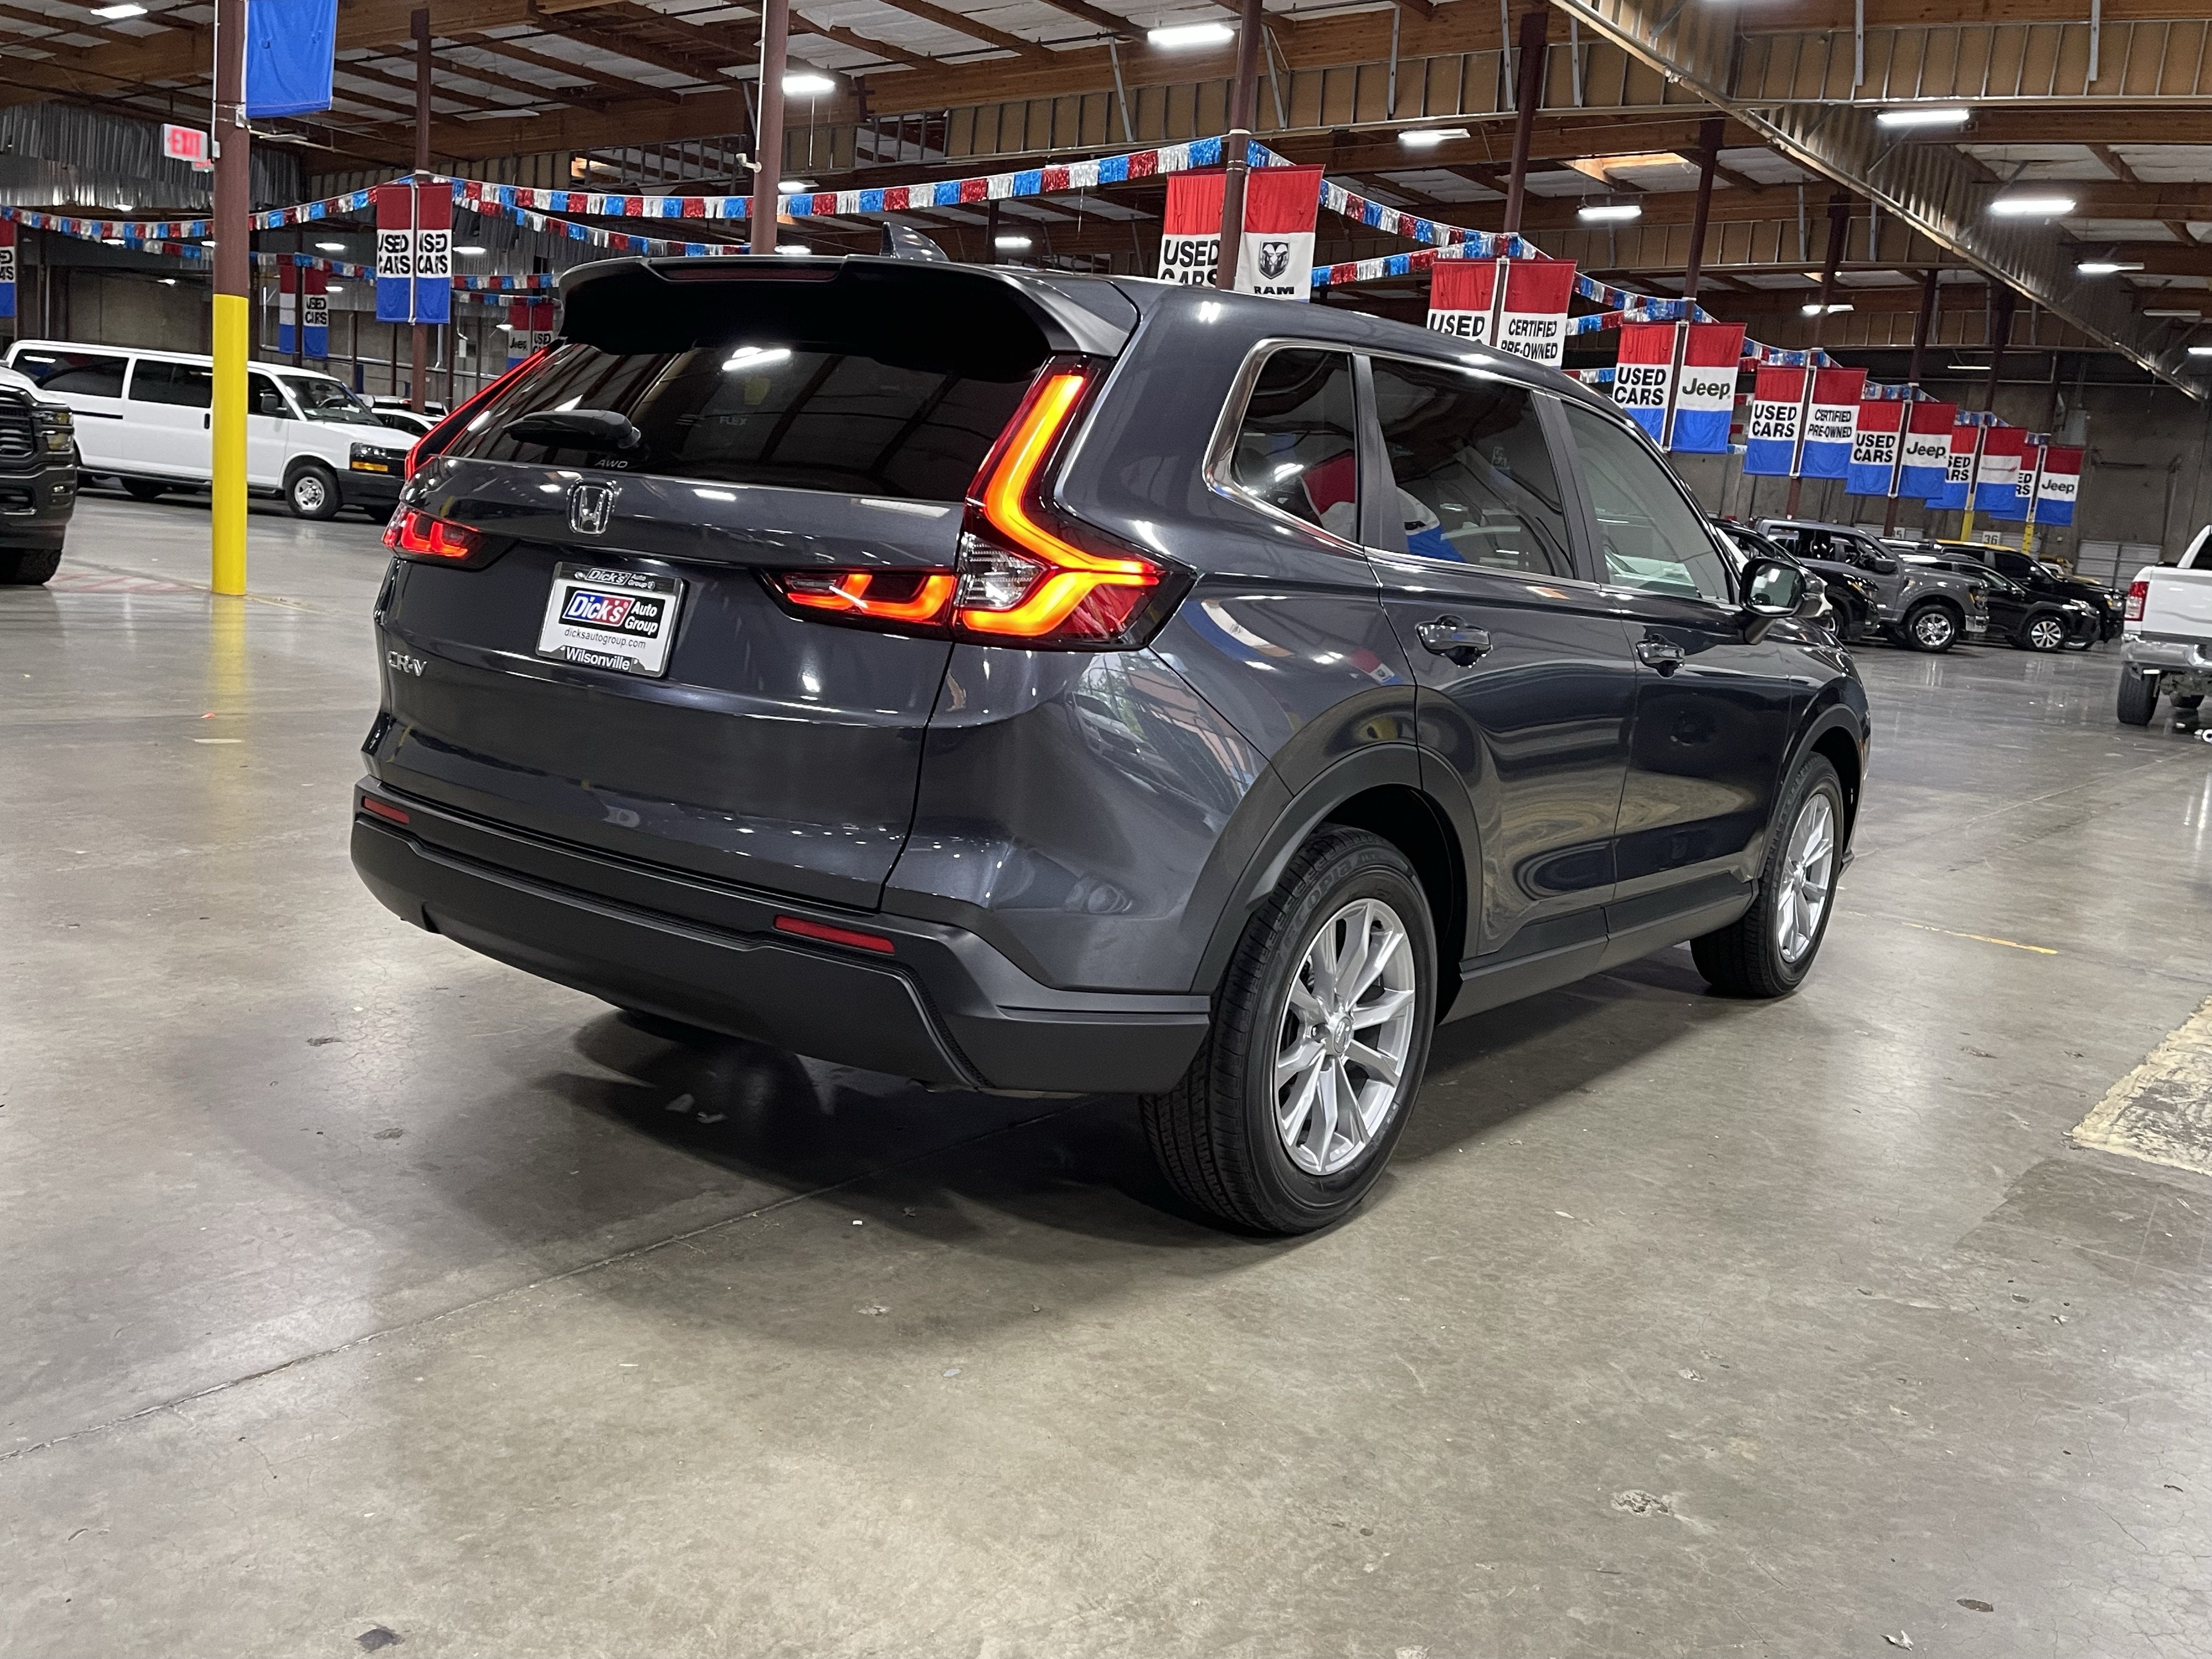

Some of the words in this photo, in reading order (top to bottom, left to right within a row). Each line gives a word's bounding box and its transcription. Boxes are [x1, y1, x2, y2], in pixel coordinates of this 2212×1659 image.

[171, 127, 201, 158] EXIT
[1163, 239, 1220, 267] USED
[1254, 286, 1295, 295] RAM
[1429, 313, 1485, 337] USED
[1509, 318, 1557, 337] CERTIFIED
[1618, 366, 1667, 386] USED
[1614, 386, 1664, 405] CARS
[1682, 378, 1730, 400] Jeep
[1754, 404, 1797, 421] USED
[1815, 409, 1851, 422] CERTIFIED
[1752, 421, 1795, 437] CARS
[1808, 424, 1852, 438] PRE-OWNED
[1856, 433, 1895, 448] USED
[1854, 448, 1893, 463] CARS
[1906, 442, 1946, 459] Jeep
[595, 459, 628, 468] AWD
[2042, 479, 2075, 493] Jeep
[1984, 534, 1998, 545] 36
[588, 569, 629, 584] Dick's
[628, 579, 648, 589] Group
[567, 596, 625, 623] Dick's
[630, 601, 658, 617] Auto
[624, 616, 658, 635] Group
[564, 628, 646, 649] dicksautogroup.com
[387, 651, 427, 676] CR-V
[566, 647, 630, 671] Wilsonville
